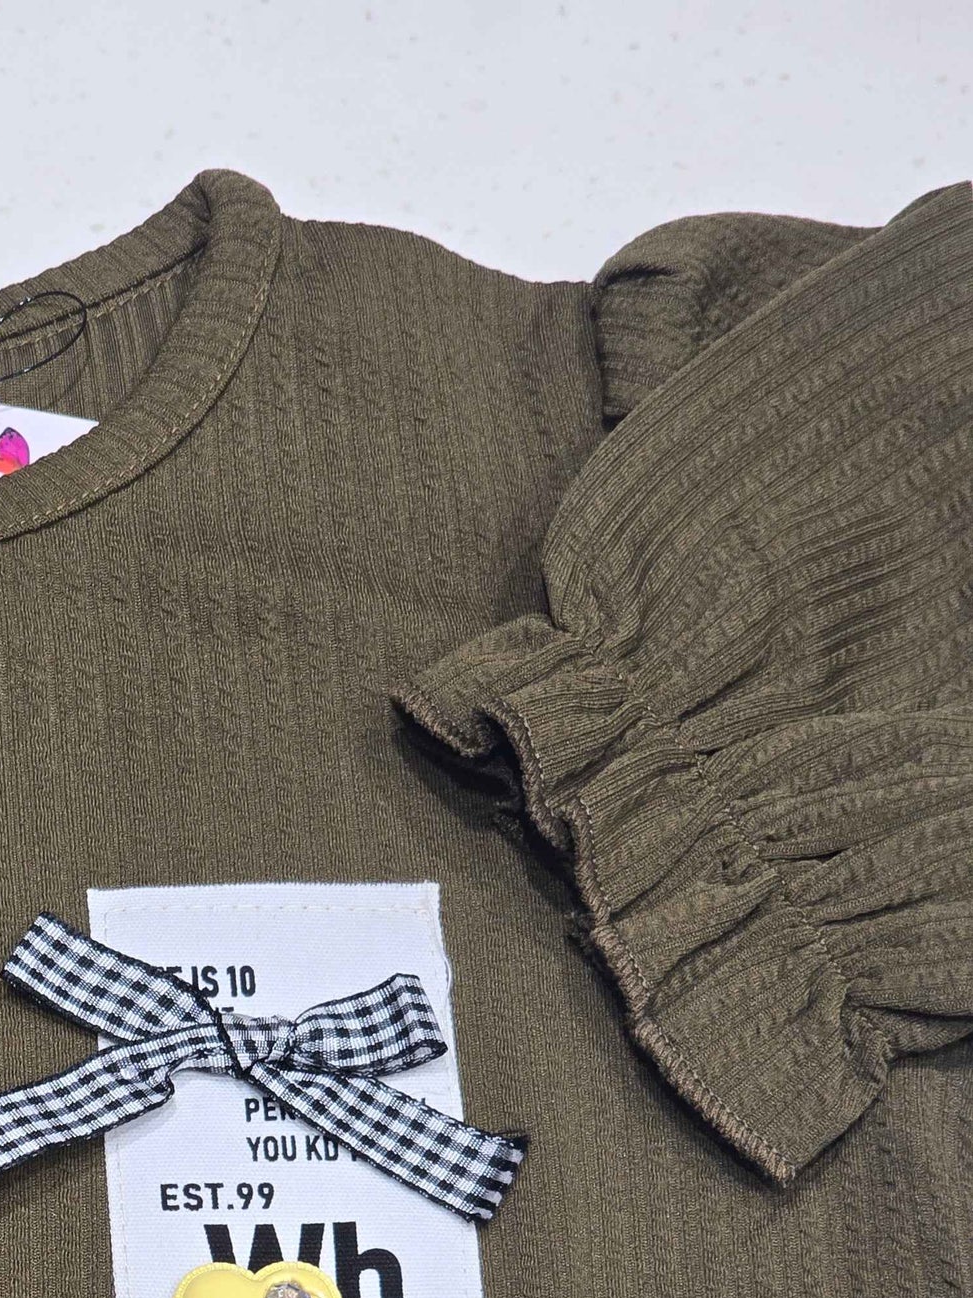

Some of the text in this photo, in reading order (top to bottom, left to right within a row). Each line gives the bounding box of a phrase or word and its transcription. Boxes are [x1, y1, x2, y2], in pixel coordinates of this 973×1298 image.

[191, 965, 256, 998] IS 10
[246, 1135, 297, 1162] YOU
[160, 1182, 276, 1212] EST.99
